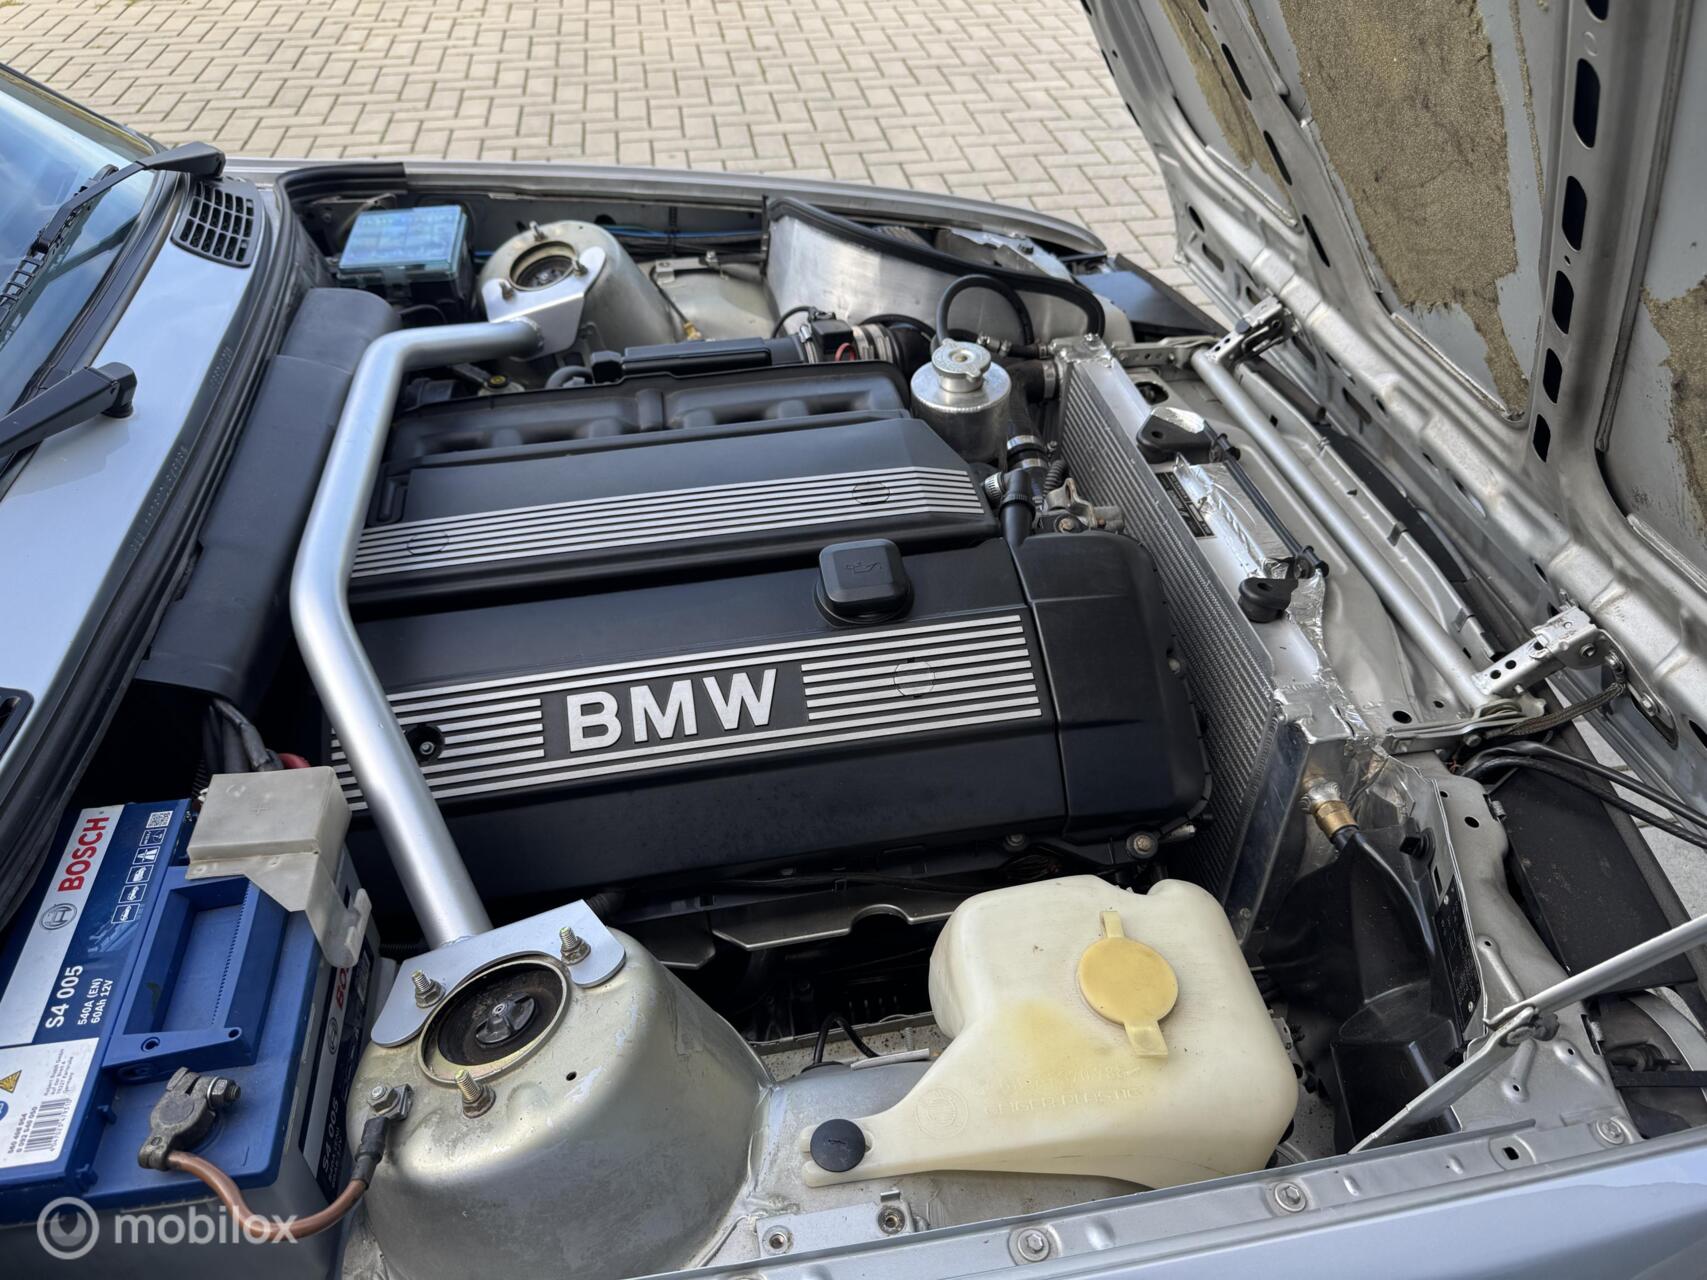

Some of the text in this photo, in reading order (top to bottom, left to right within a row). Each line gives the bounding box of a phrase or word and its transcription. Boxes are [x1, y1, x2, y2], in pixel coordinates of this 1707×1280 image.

[566, 668, 777, 752] BMW
[57, 816, 110, 892] BOSCH
[45, 964, 84, 1029] S4 005
[77, 977, 104, 1025] 540A (EN)
[90, 979, 114, 1024] 60Ah 12V
